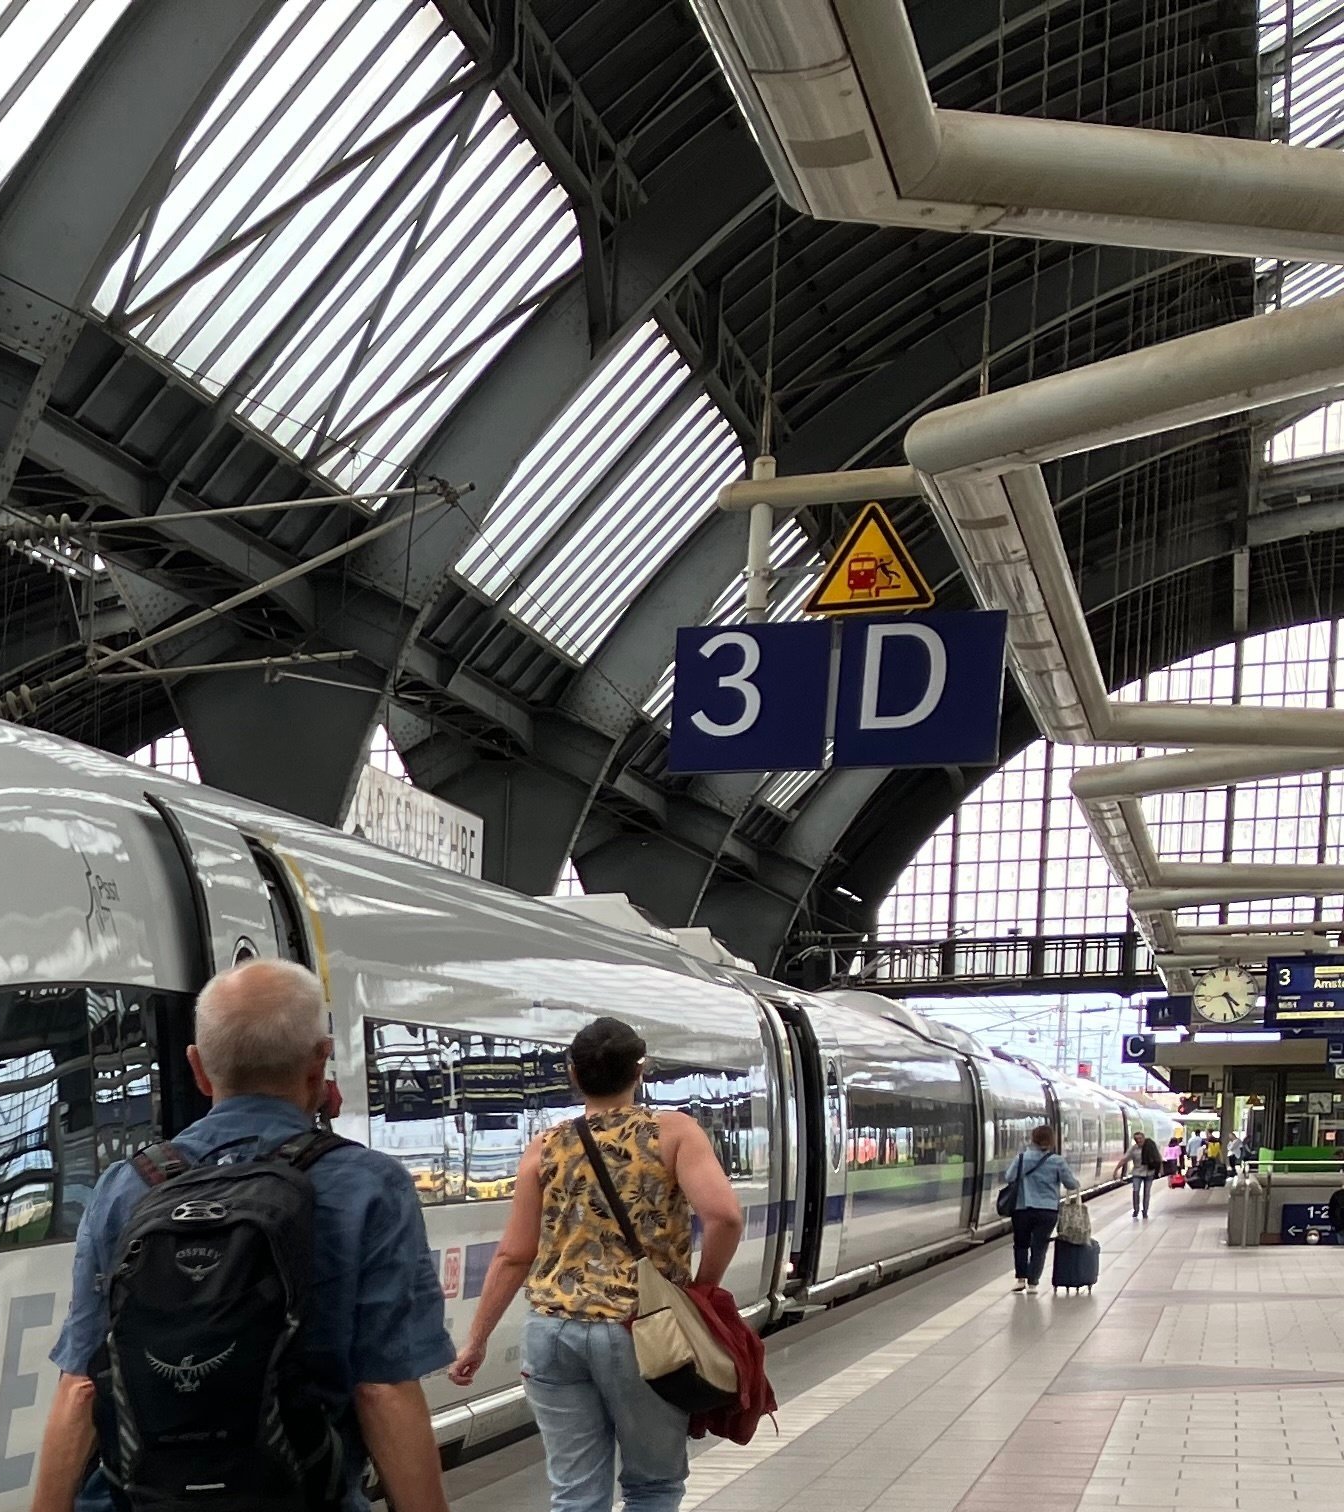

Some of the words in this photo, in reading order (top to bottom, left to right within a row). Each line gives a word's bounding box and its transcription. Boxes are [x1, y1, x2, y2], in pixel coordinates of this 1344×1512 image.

[691, 631, 761, 738] 3
[860, 622, 947, 730] D
[1278, 968, 1292, 987] 3
[1125, 1034, 1145, 1058] C
